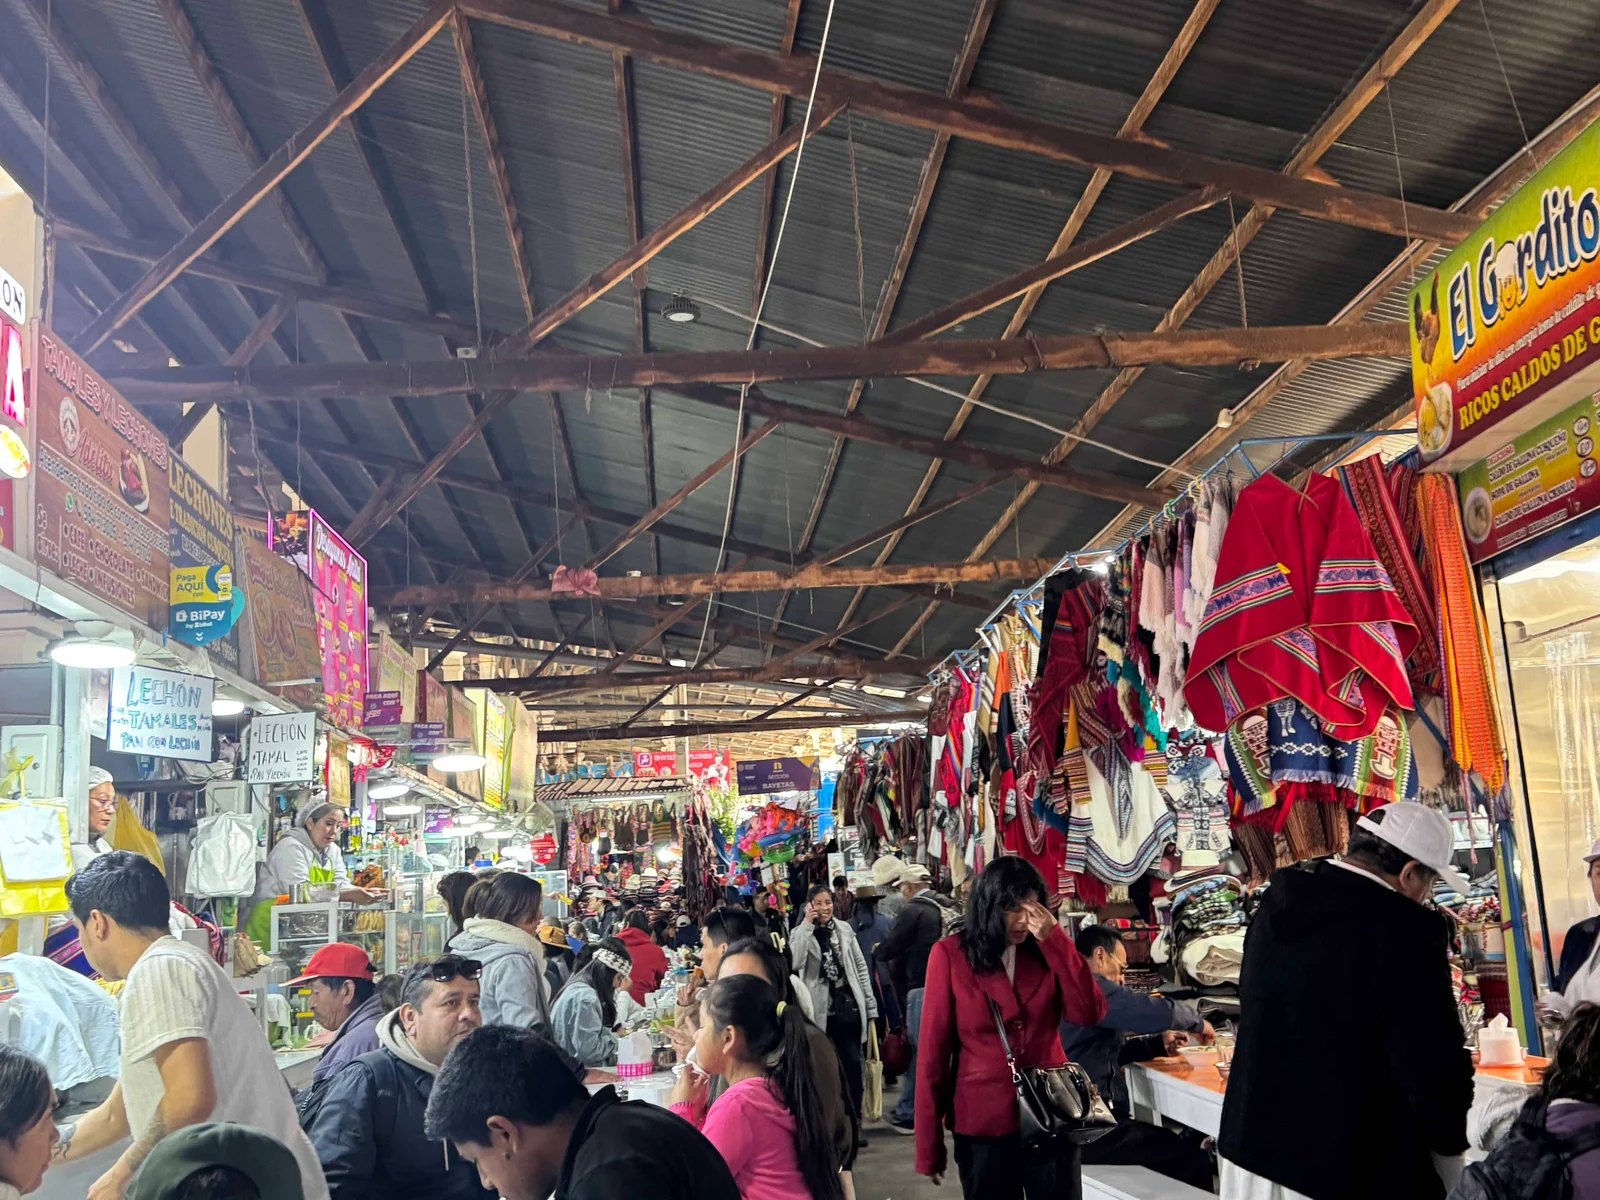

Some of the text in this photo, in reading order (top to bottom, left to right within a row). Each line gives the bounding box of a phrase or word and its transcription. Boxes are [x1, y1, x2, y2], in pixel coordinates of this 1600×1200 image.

[1448, 261, 1476, 361] El
[1458, 382, 1500, 431] RICOS
[1500, 342, 1561, 402] CALDOS
[1562, 325, 1587, 363] DE
[42, 335, 168, 470] TAMALES Y LECHONES
[168, 454, 232, 542] LECHONES
[176, 574, 196, 582] Paga
[176, 579, 204, 593] AQUÍ
[190, 610, 226, 621] BiPay
[126, 671, 201, 708] LECHÓN
[128, 710, 197, 730] TAMALES
[258, 717, 306, 744] LECHÓN
[120, 732, 143, 749] PAN
[255, 750, 291, 766] TAMAL
[252, 768, 264, 780] PAN
[762, 781, 795, 790] BAYETAS
